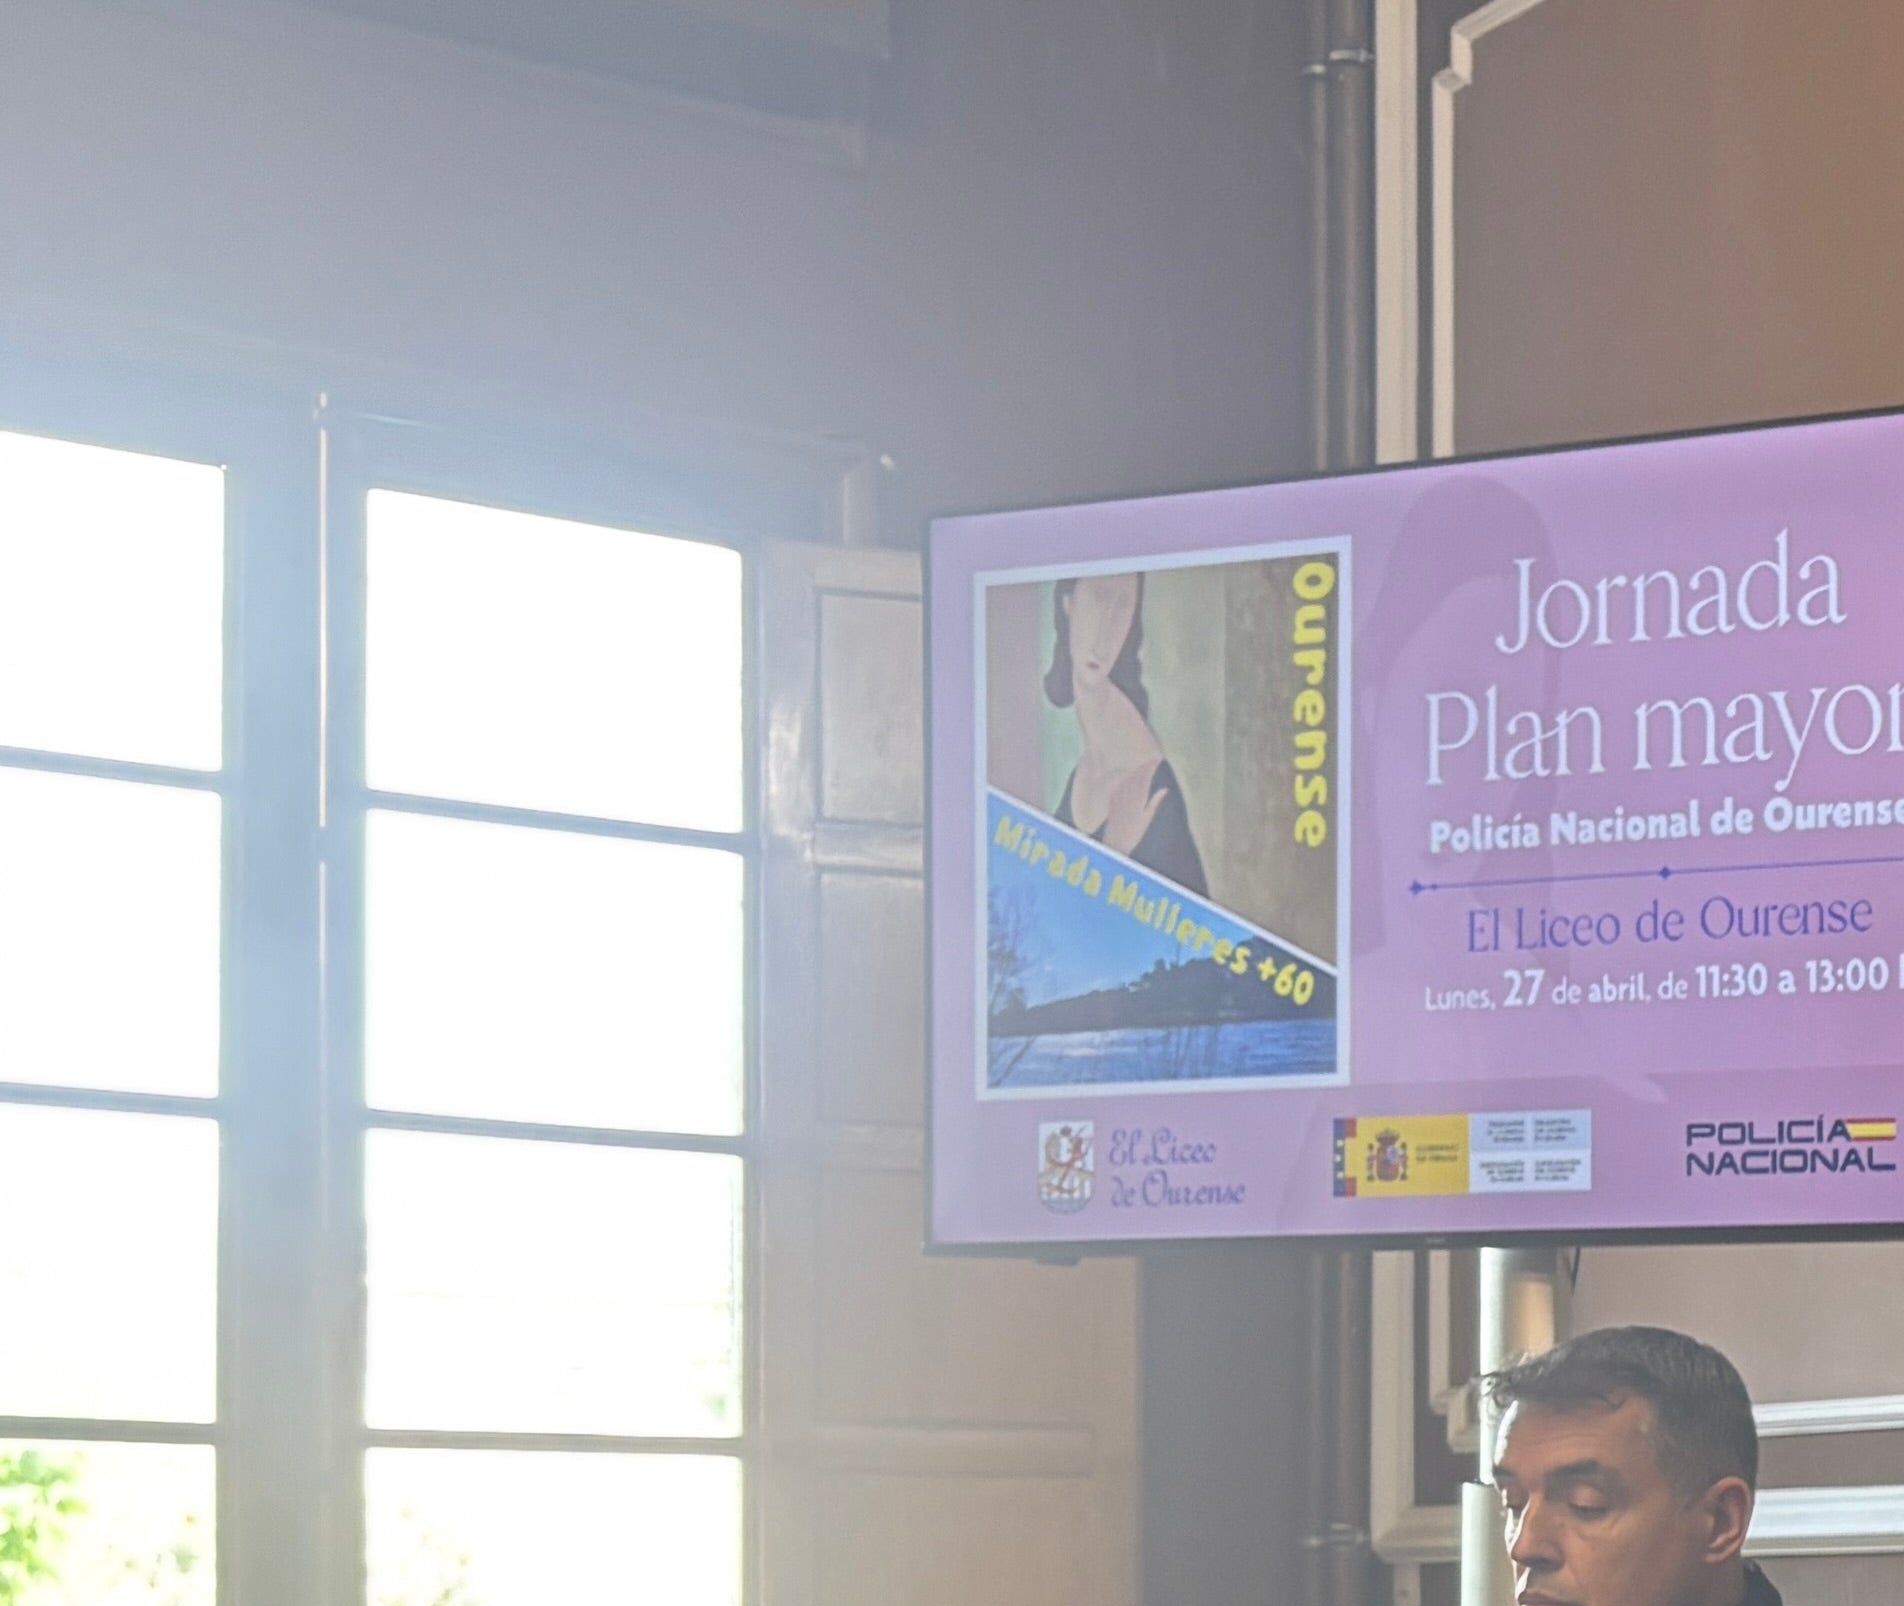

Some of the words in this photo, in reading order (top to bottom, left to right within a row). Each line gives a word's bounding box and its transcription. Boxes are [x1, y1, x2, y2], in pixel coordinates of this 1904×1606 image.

[1495, 527, 1847, 654] Jornada
[1293, 562, 1335, 847] Ourense
[1424, 684, 1606, 786] Plan
[1430, 813, 1540, 853] Policía
[1550, 800, 1700, 846] Nacional
[1710, 797, 1753, 836] de
[993, 816, 1102, 896] Mirada
[1107, 875, 1250, 975] Mulleres
[1257, 956, 1315, 1005] +60
[1468, 909, 1500, 953] El
[1516, 906, 1620, 950] Liceo
[1635, 898, 1684, 942] de
[1700, 896, 1873, 938] Ourense
[1425, 986, 1496, 1011] Lunes,
[1502, 968, 1545, 1007] 27
[1552, 979, 1582, 1003] de
[1588, 973, 1651, 1002] abril,
[1657, 972, 1688, 1000] de
[1695, 963, 1767, 997] 11:30
[1778, 969, 1796, 993] a
[1805, 957, 1888, 993] 13:00
[1142, 1127, 1216, 1165] Liceo
[1686, 1114, 1852, 1147] POLICÍA
[1142, 1169, 1246, 1207] Ourense
[1687, 1147, 1896, 1177] NACIONAL
